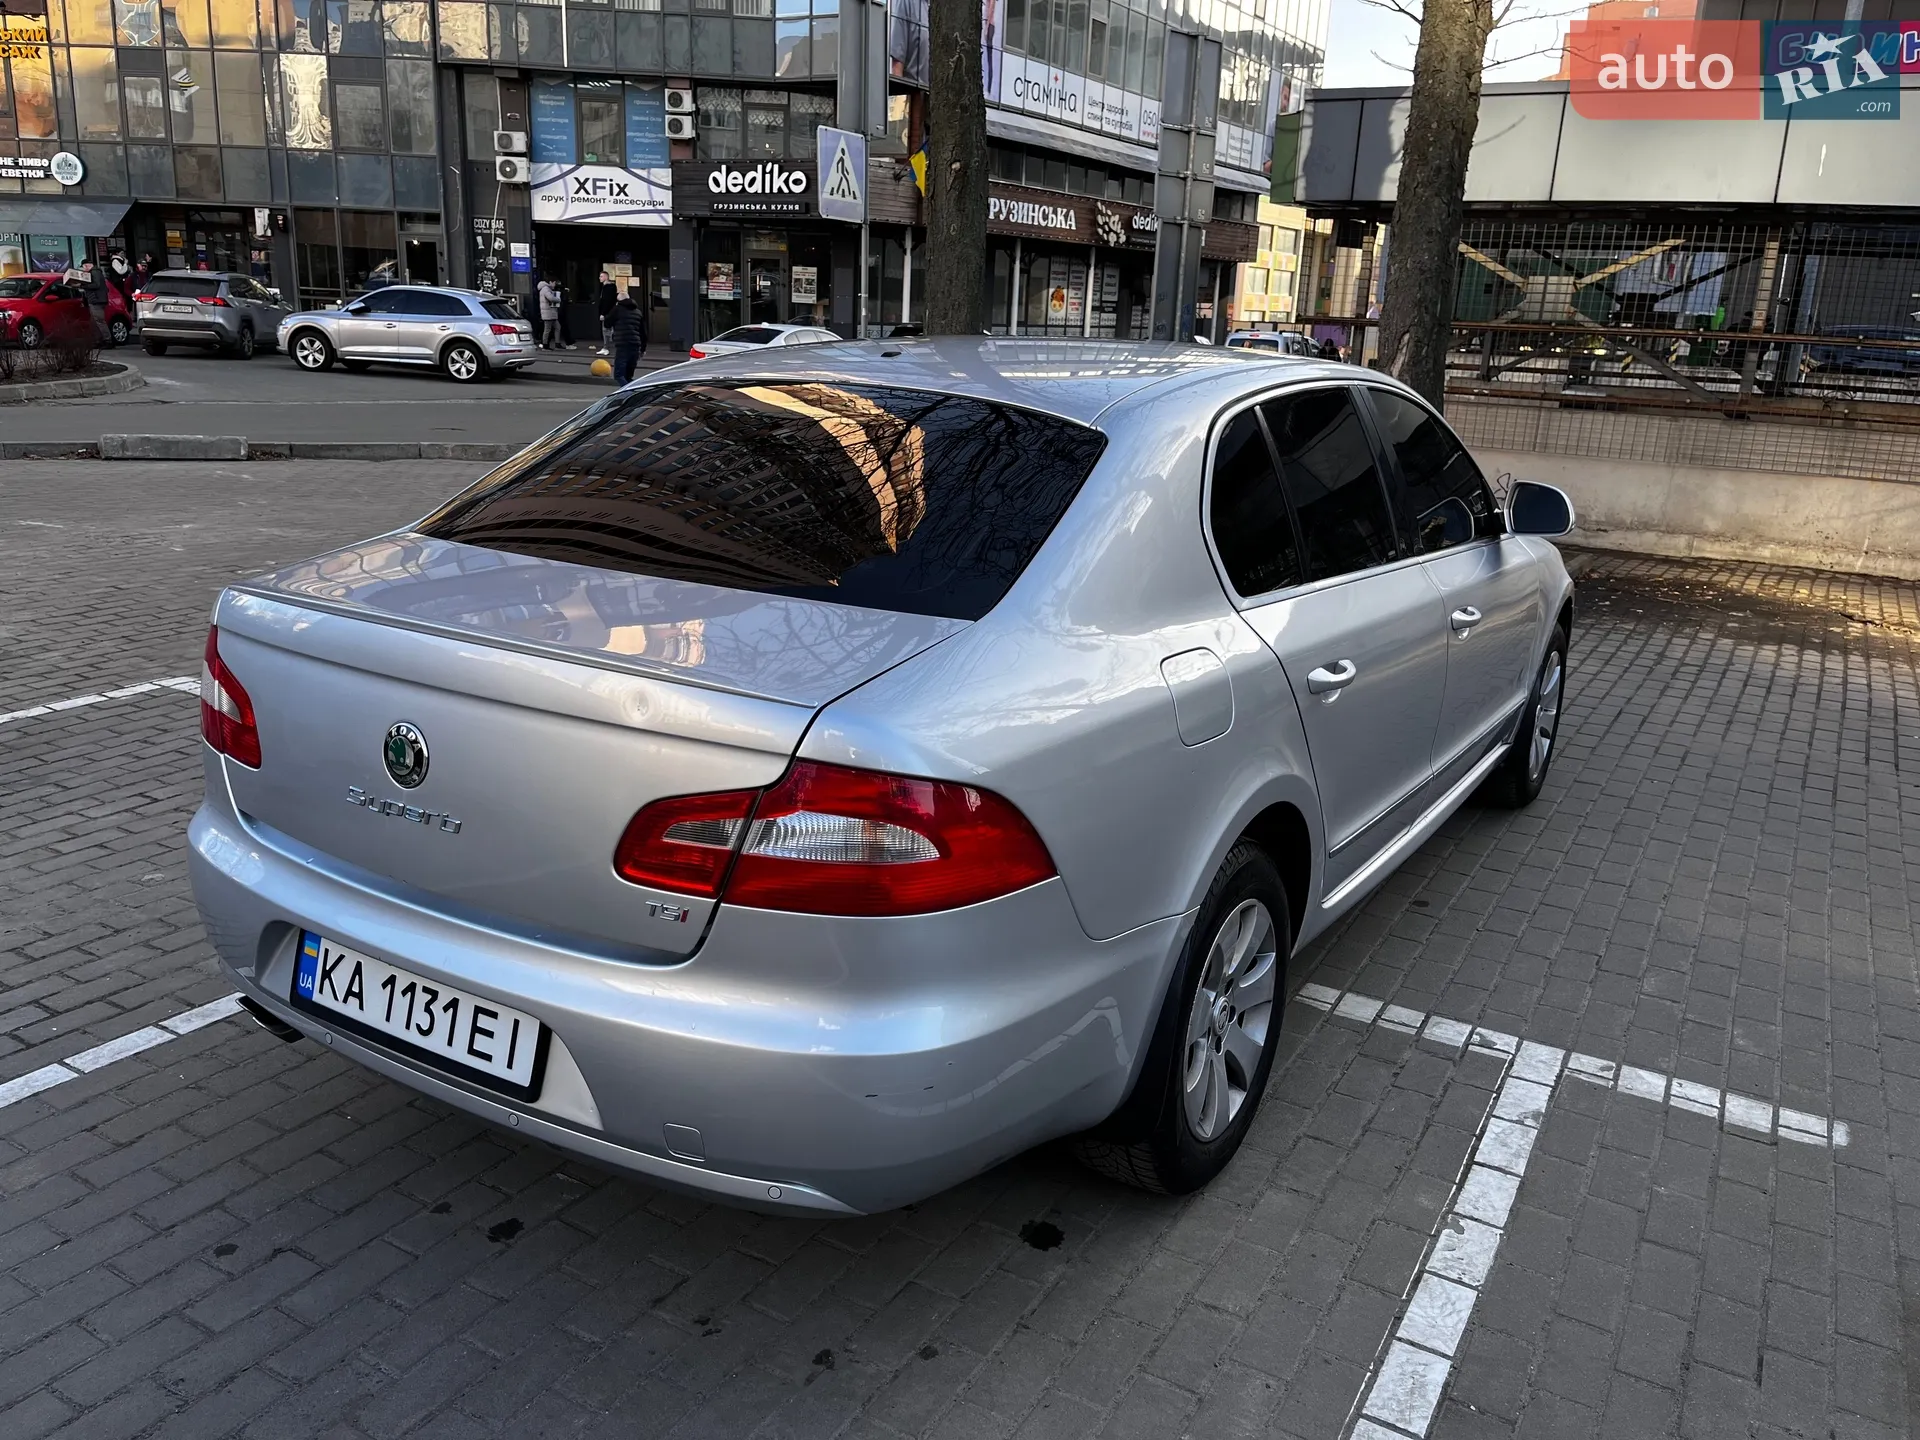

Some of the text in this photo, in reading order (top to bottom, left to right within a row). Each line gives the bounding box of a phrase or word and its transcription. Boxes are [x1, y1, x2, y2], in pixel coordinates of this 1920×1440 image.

[1104, 117, 1111, 125] та
[19, 158, 49, 167] ПИВО
[573, 177, 629, 197] XFix
[708, 162, 807, 194] dediko
[570, 196, 607, 204] ремонт
[612, 198, 665, 207] аксесуари
[473, 218, 490, 228] COZY
[988, 197, 1077, 231] РУЗИНСЬКА
[346, 786, 462, 834] Superb
[299, 972, 313, 991] UA
